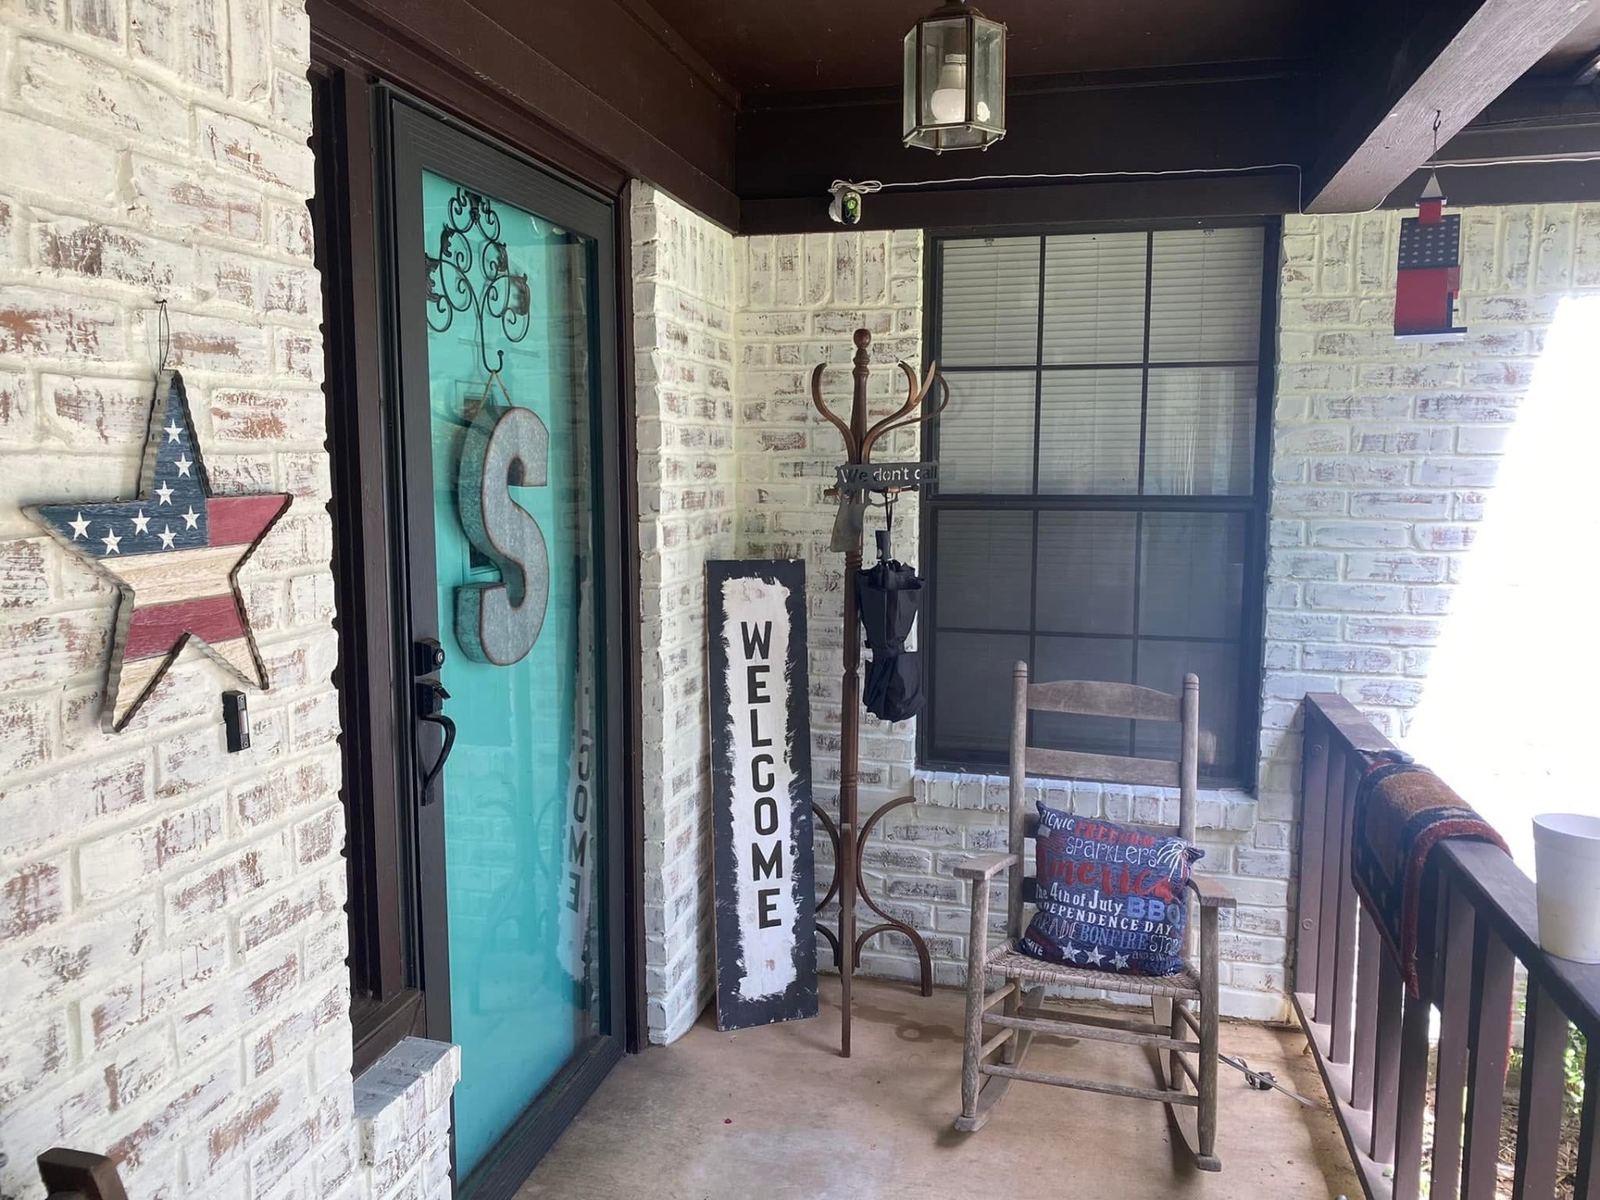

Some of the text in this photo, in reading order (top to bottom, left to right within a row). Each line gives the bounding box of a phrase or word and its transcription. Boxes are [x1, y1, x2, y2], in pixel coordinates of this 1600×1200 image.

[840, 465, 938, 483] We don't call
[456, 406, 550, 666] S
[741, 621, 783, 930] WELCOME
[1041, 809, 1075, 831] PICNIC
[1037, 848, 1176, 902] meric
[1050, 882, 1070, 902] 4th
[1073, 893, 1086, 907] of
[1088, 890, 1124, 914] July
[1040, 902, 1173, 936] DEPENDENCE DAY
[1080, 926, 1148, 951] BONFIRE
